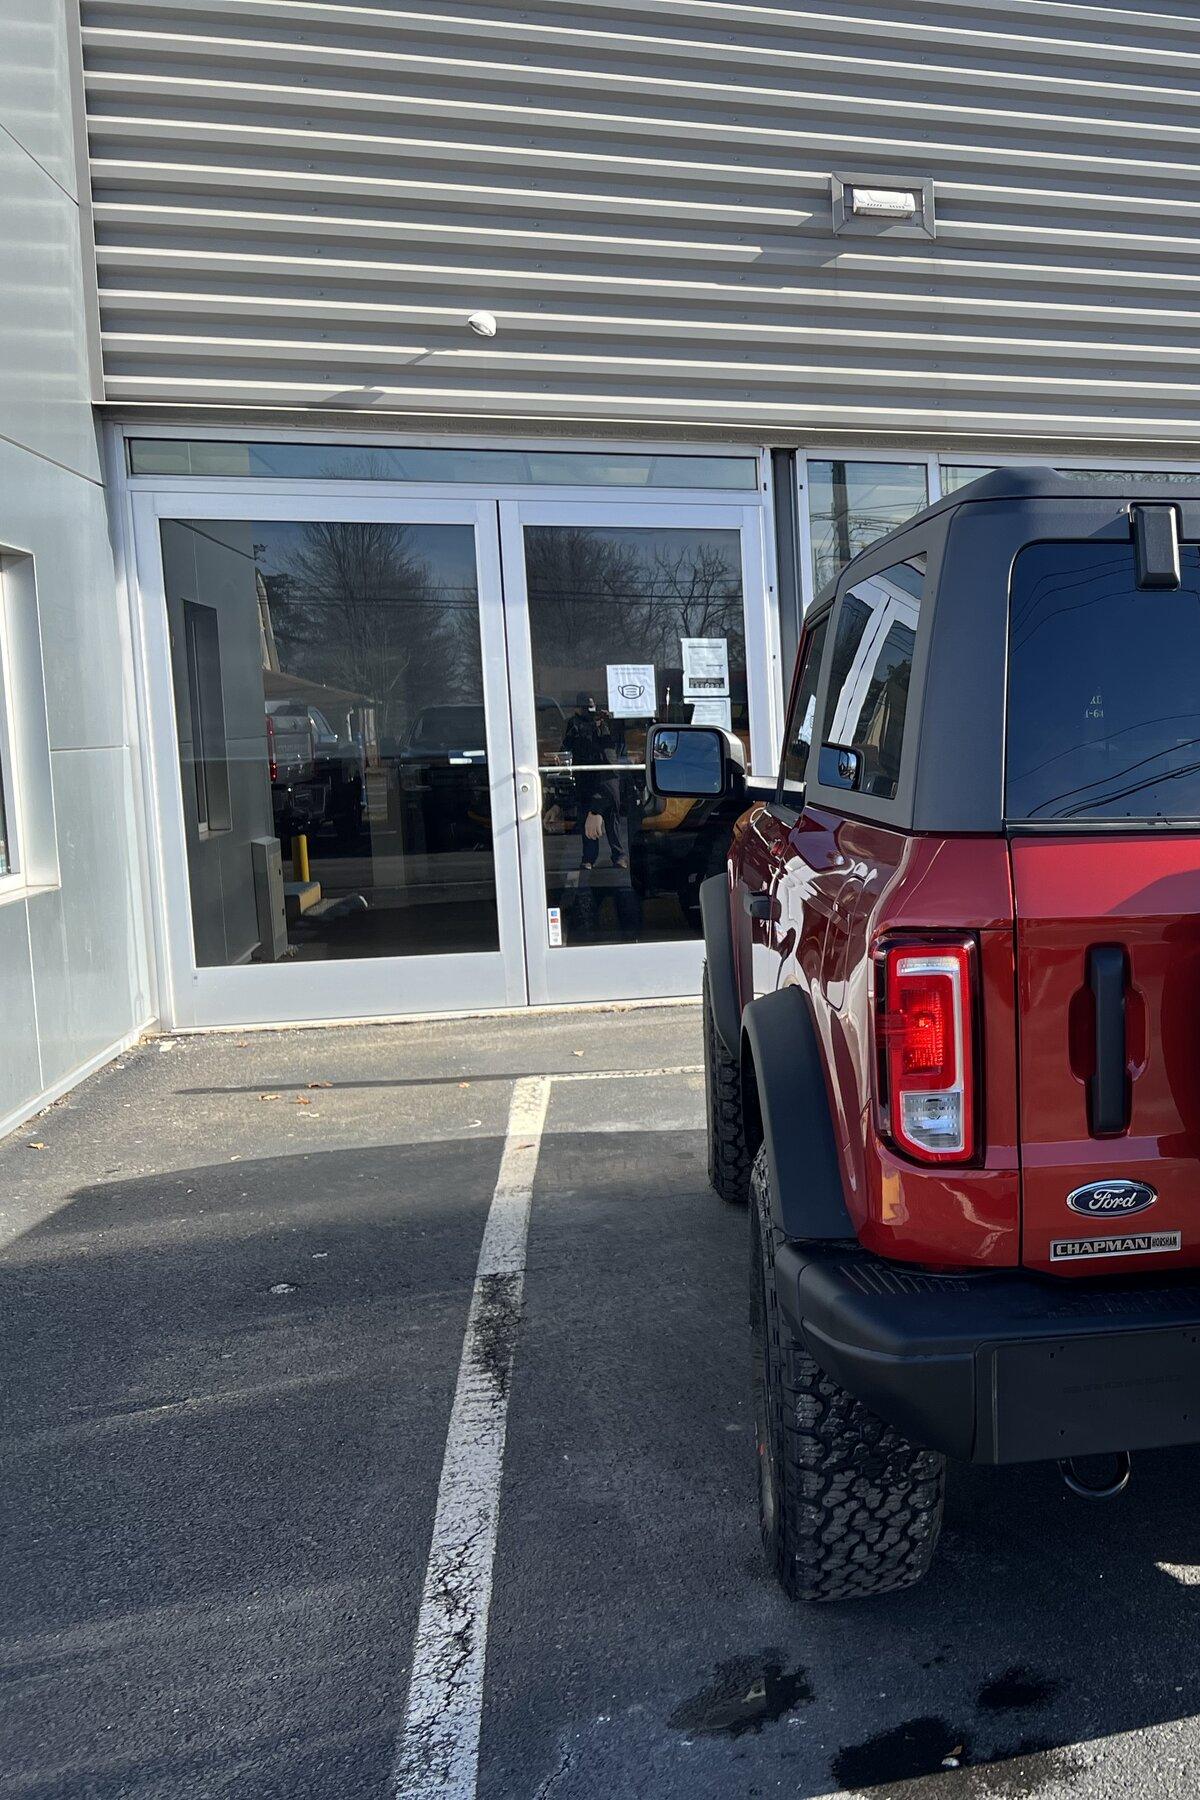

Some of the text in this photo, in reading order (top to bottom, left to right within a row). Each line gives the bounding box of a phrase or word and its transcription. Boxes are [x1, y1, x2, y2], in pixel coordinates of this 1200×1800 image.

[1088, 1188, 1137, 1210] Ford
[1056, 1234, 1178, 1255] CHAPMAN HORSHAM
